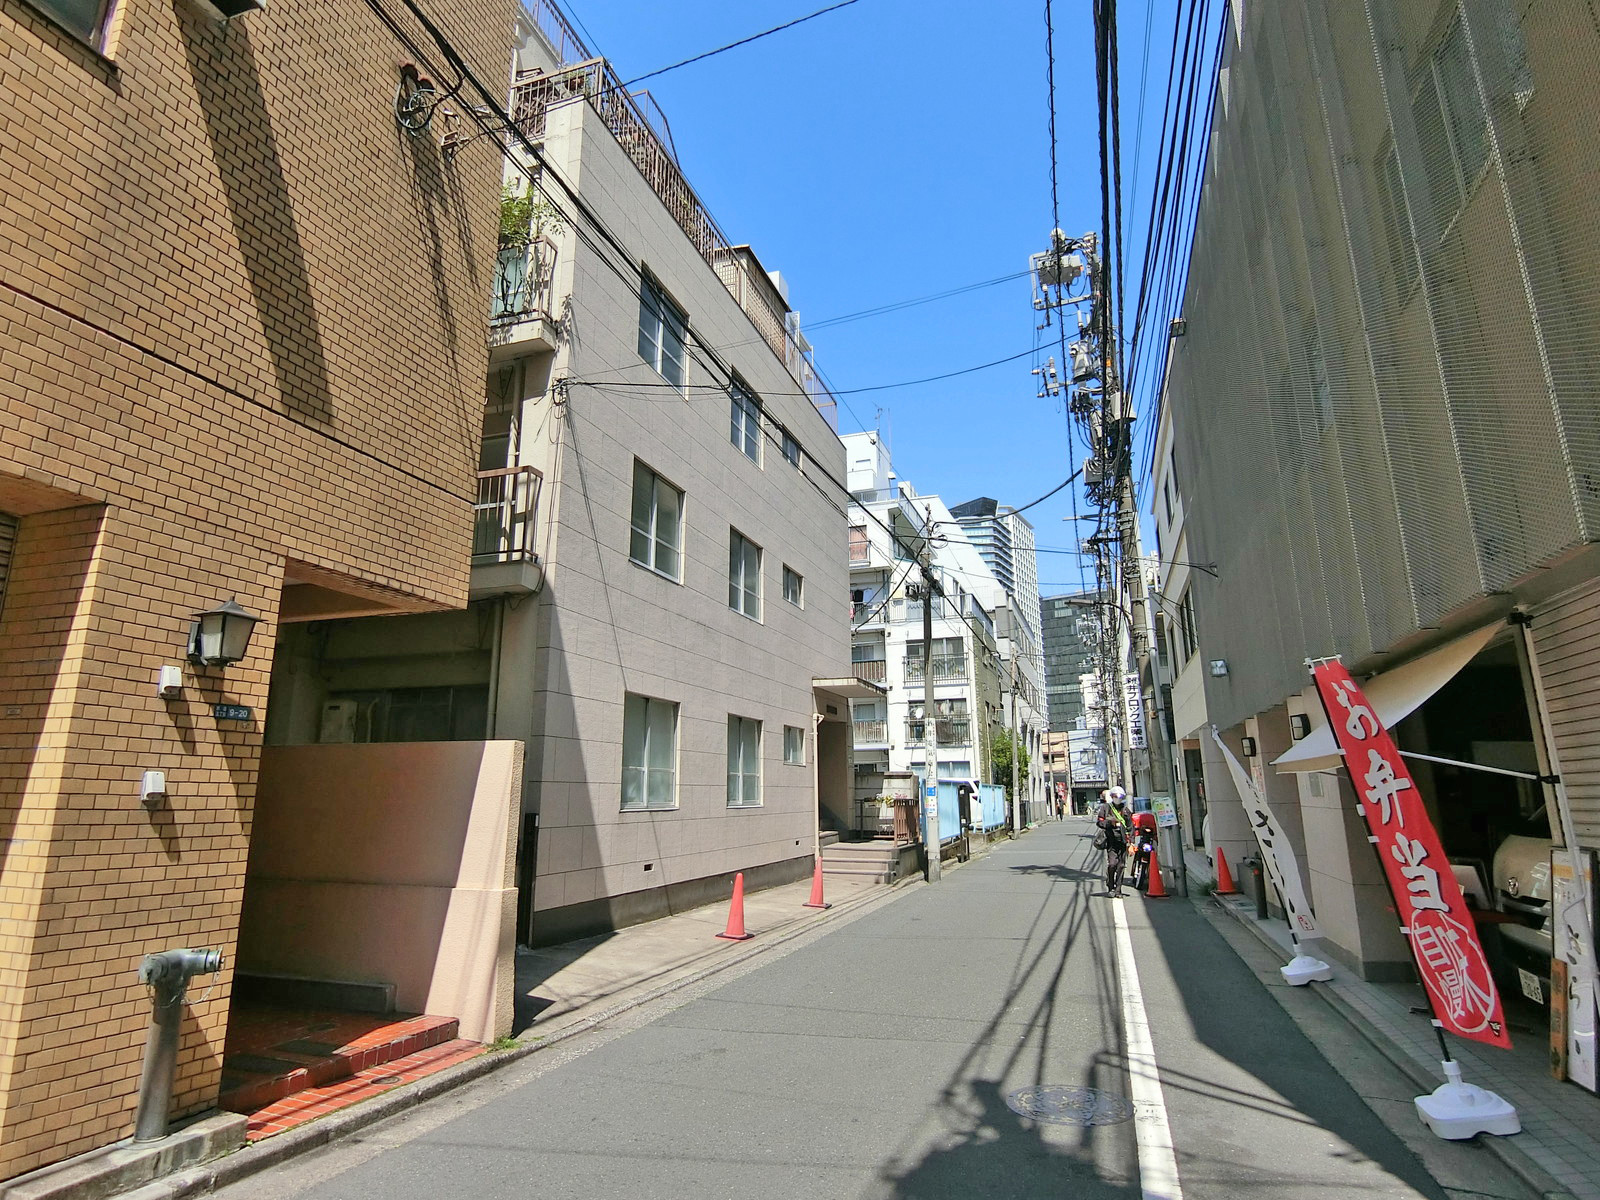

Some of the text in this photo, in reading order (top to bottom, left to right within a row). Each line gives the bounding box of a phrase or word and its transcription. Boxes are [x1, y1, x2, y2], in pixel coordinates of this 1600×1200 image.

[229, 708, 248, 717] 9-20
[1331, 680, 1449, 912] お弁当
